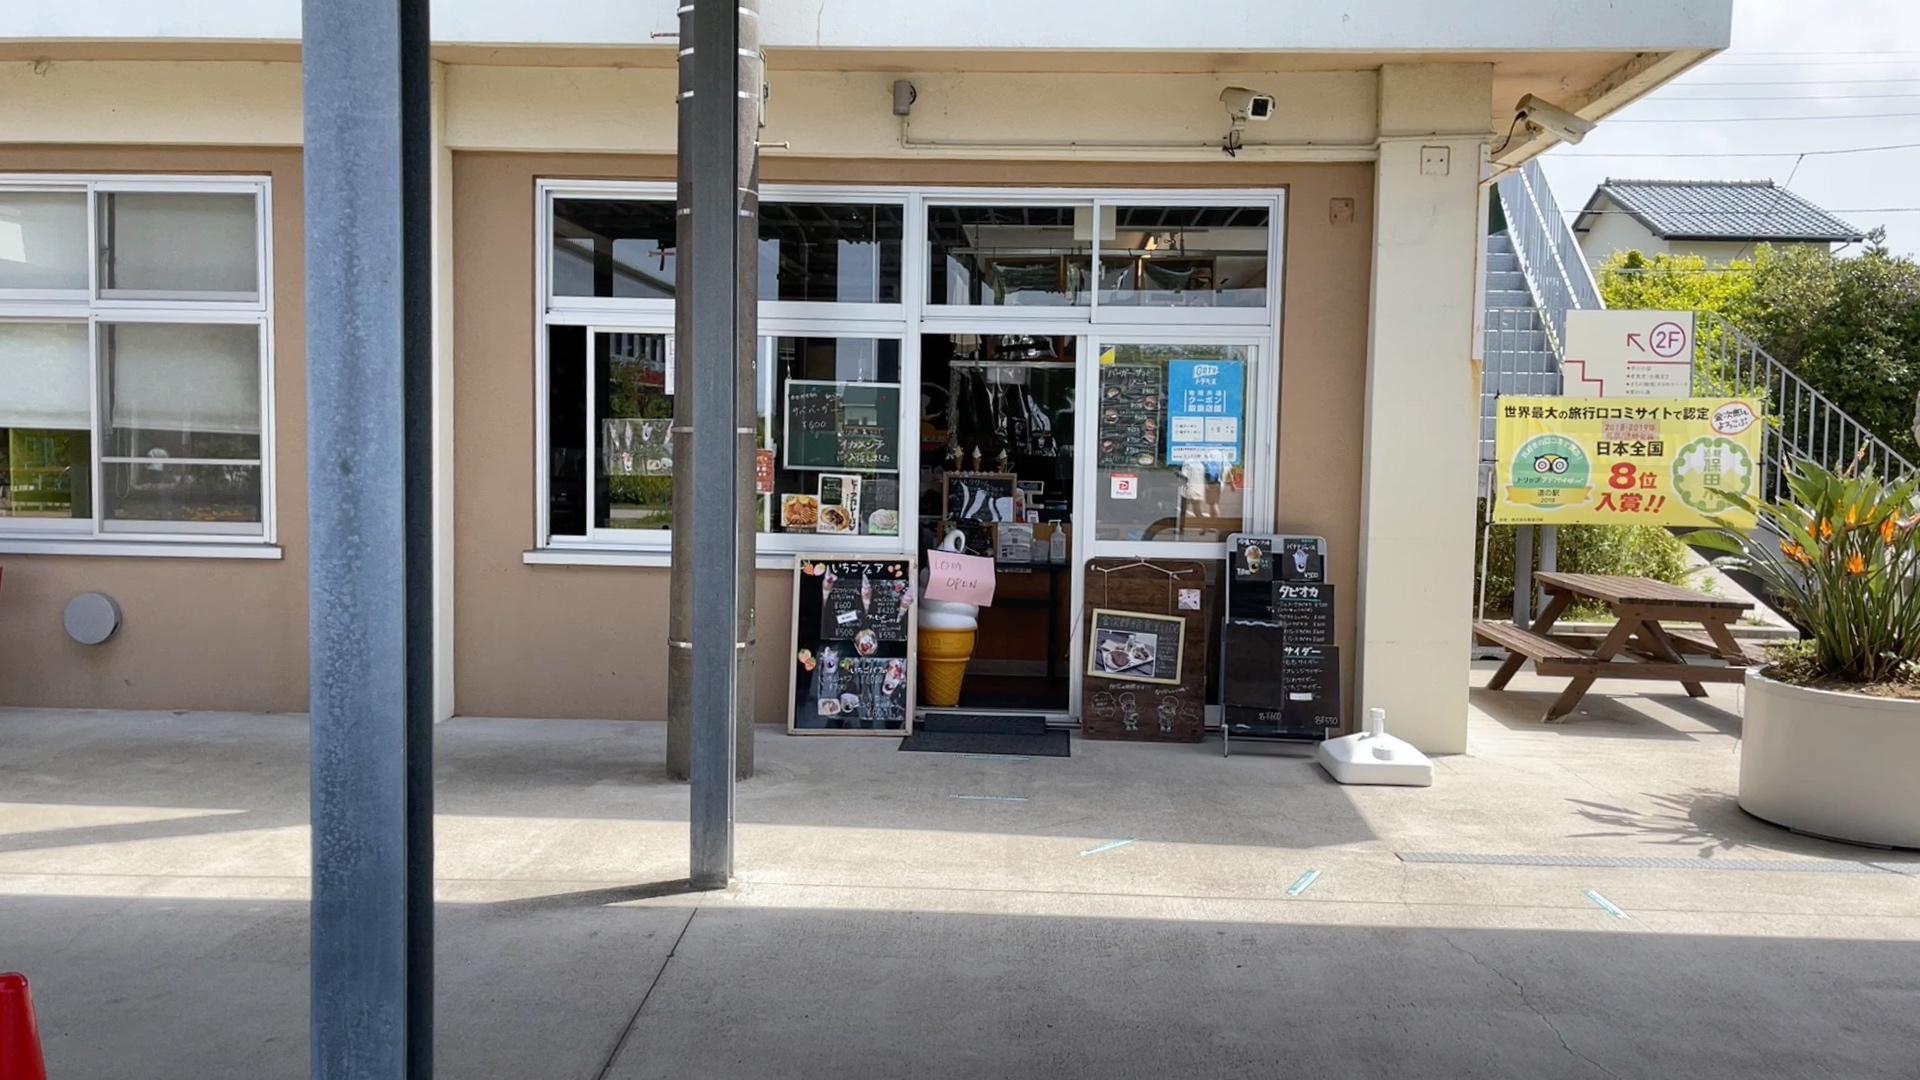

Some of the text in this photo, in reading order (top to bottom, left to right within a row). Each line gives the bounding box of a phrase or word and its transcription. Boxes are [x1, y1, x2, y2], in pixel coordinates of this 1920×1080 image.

[1655, 331, 1680, 349] 2F
[1188, 396, 1222, 404] クーポン
[1504, 405, 1709, 420] 世界最大の旅行口コミサイトで認定
[839, 439, 884, 450] イカメンチ
[1597, 440, 1663, 457] 日本全国
[1608, 463, 1657, 490] 8位
[1537, 489, 1560, 497] 道の駅
[831, 562, 884, 575] いちごフェア
[946, 576, 978, 590] OPEN
[1279, 585, 1319, 599] タピオカ
[1283, 646, 1321, 657] サイダー
